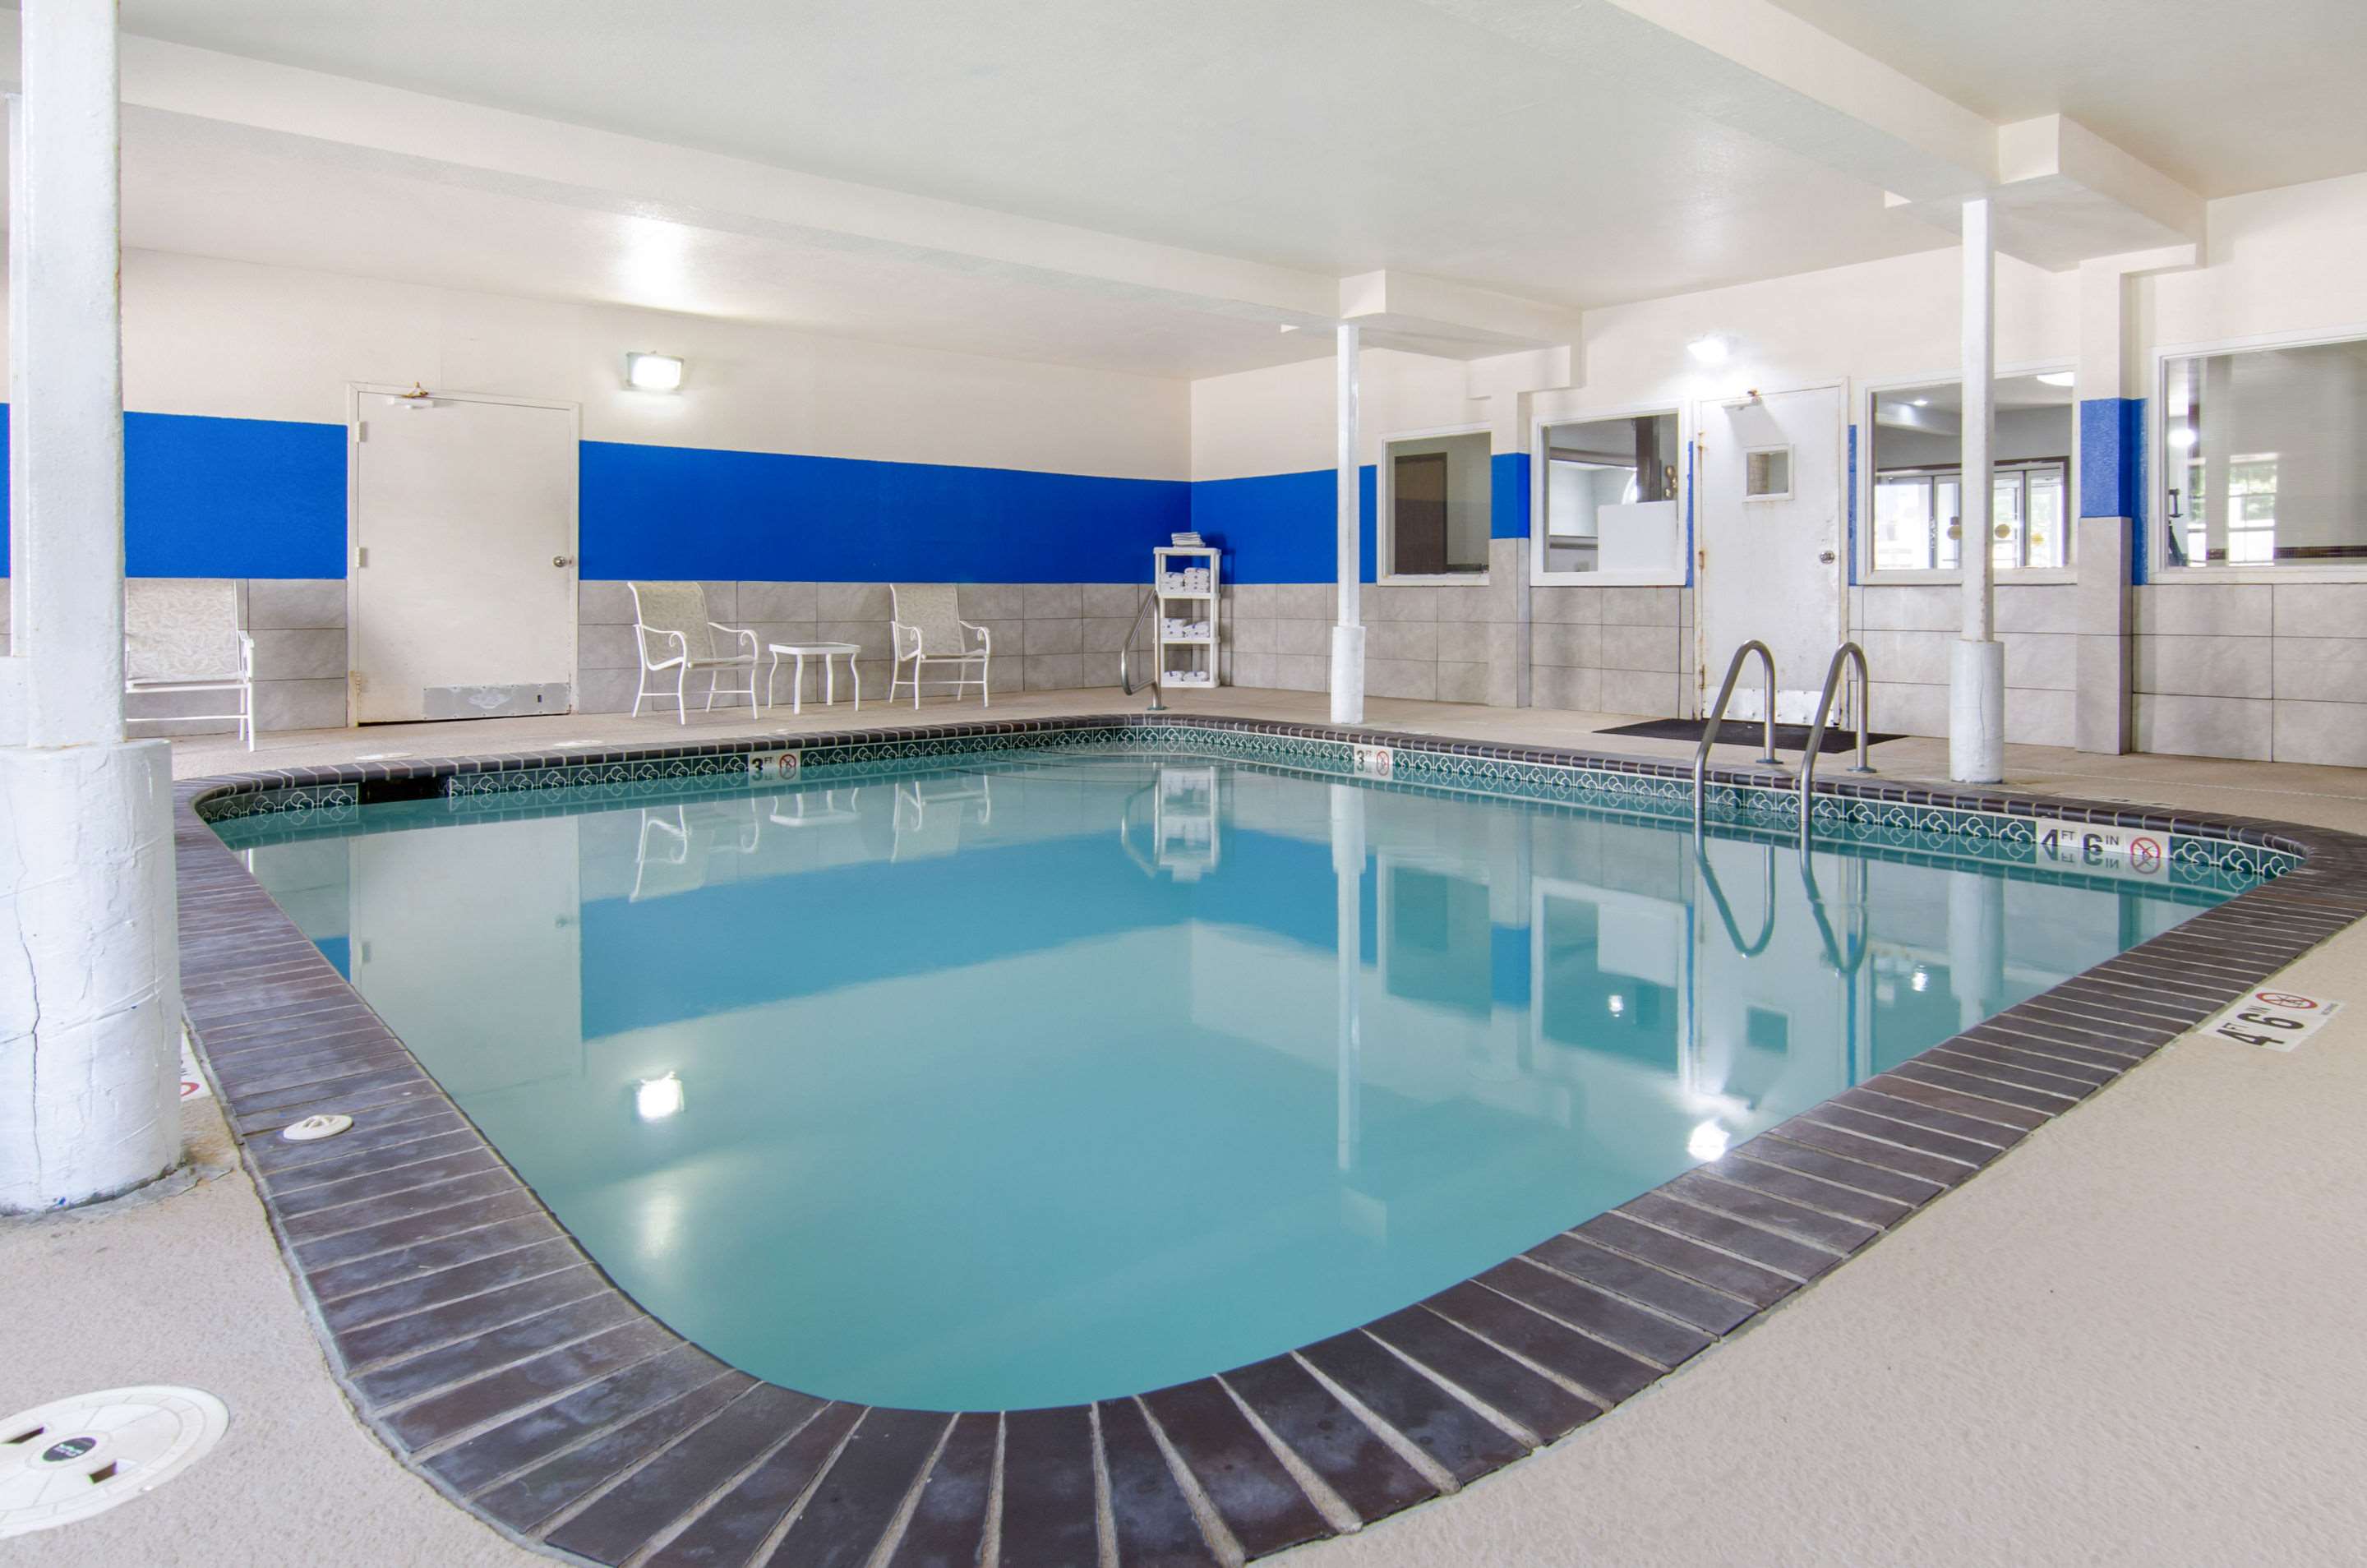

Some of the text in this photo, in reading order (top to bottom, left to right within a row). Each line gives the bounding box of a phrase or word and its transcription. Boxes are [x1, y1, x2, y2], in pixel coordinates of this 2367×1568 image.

[751, 758, 764, 771] 3
[1356, 749, 1365, 763] 3
[2041, 828, 2120, 851] 4 FT 6 IN
[2236, 1012, 2305, 1030] 6
[2216, 1028, 2285, 1046] 4
